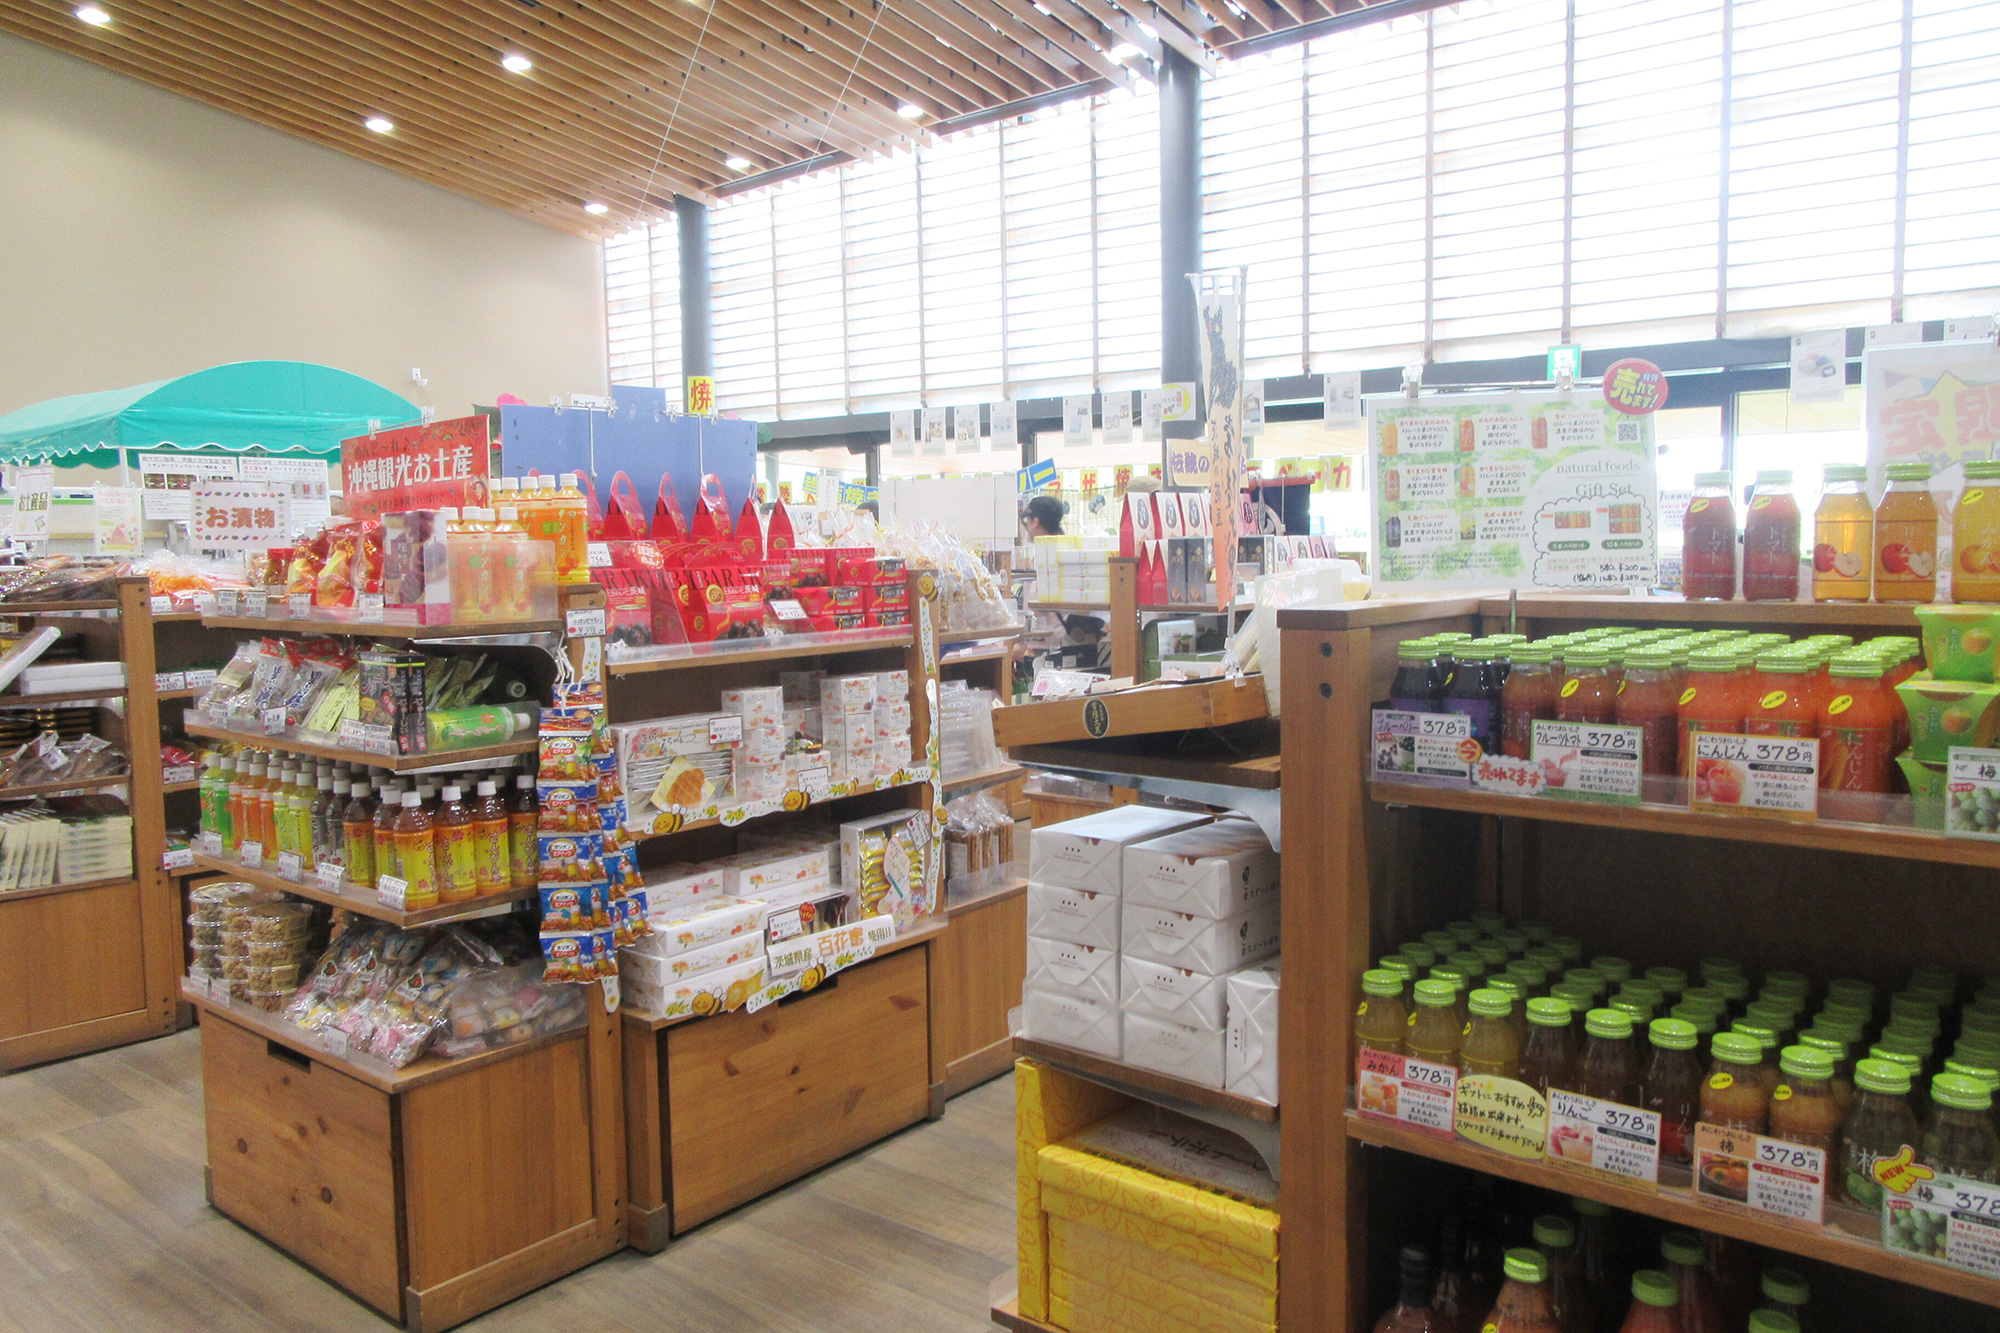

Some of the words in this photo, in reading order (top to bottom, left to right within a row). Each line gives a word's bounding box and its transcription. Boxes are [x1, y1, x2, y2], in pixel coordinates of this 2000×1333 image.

[348, 444, 474, 494] 沖縄観光お土産
[1557, 461, 1601, 474] natural
[1606, 459, 1640, 473] foods
[1576, 483, 1605, 497] Gift
[1609, 482, 1632, 496] Set
[205, 506, 276, 529] お漬物
[1377, 718, 1420, 732] ブルーベリー
[1536, 732, 1581, 747] フルーツトマト
[1459, 742, 1478, 759] 今
[1697, 744, 1750, 760] にんじん
[1846, 732, 1863, 790] にんじん
[1478, 761, 1541, 789] 売れてます
[1367, 1060, 1400, 1076] みかん
[1557, 1101, 1592, 1120] りんご
[1719, 1138, 1735, 1154] 柿
[1880, 1163, 1905, 1181] NEW
